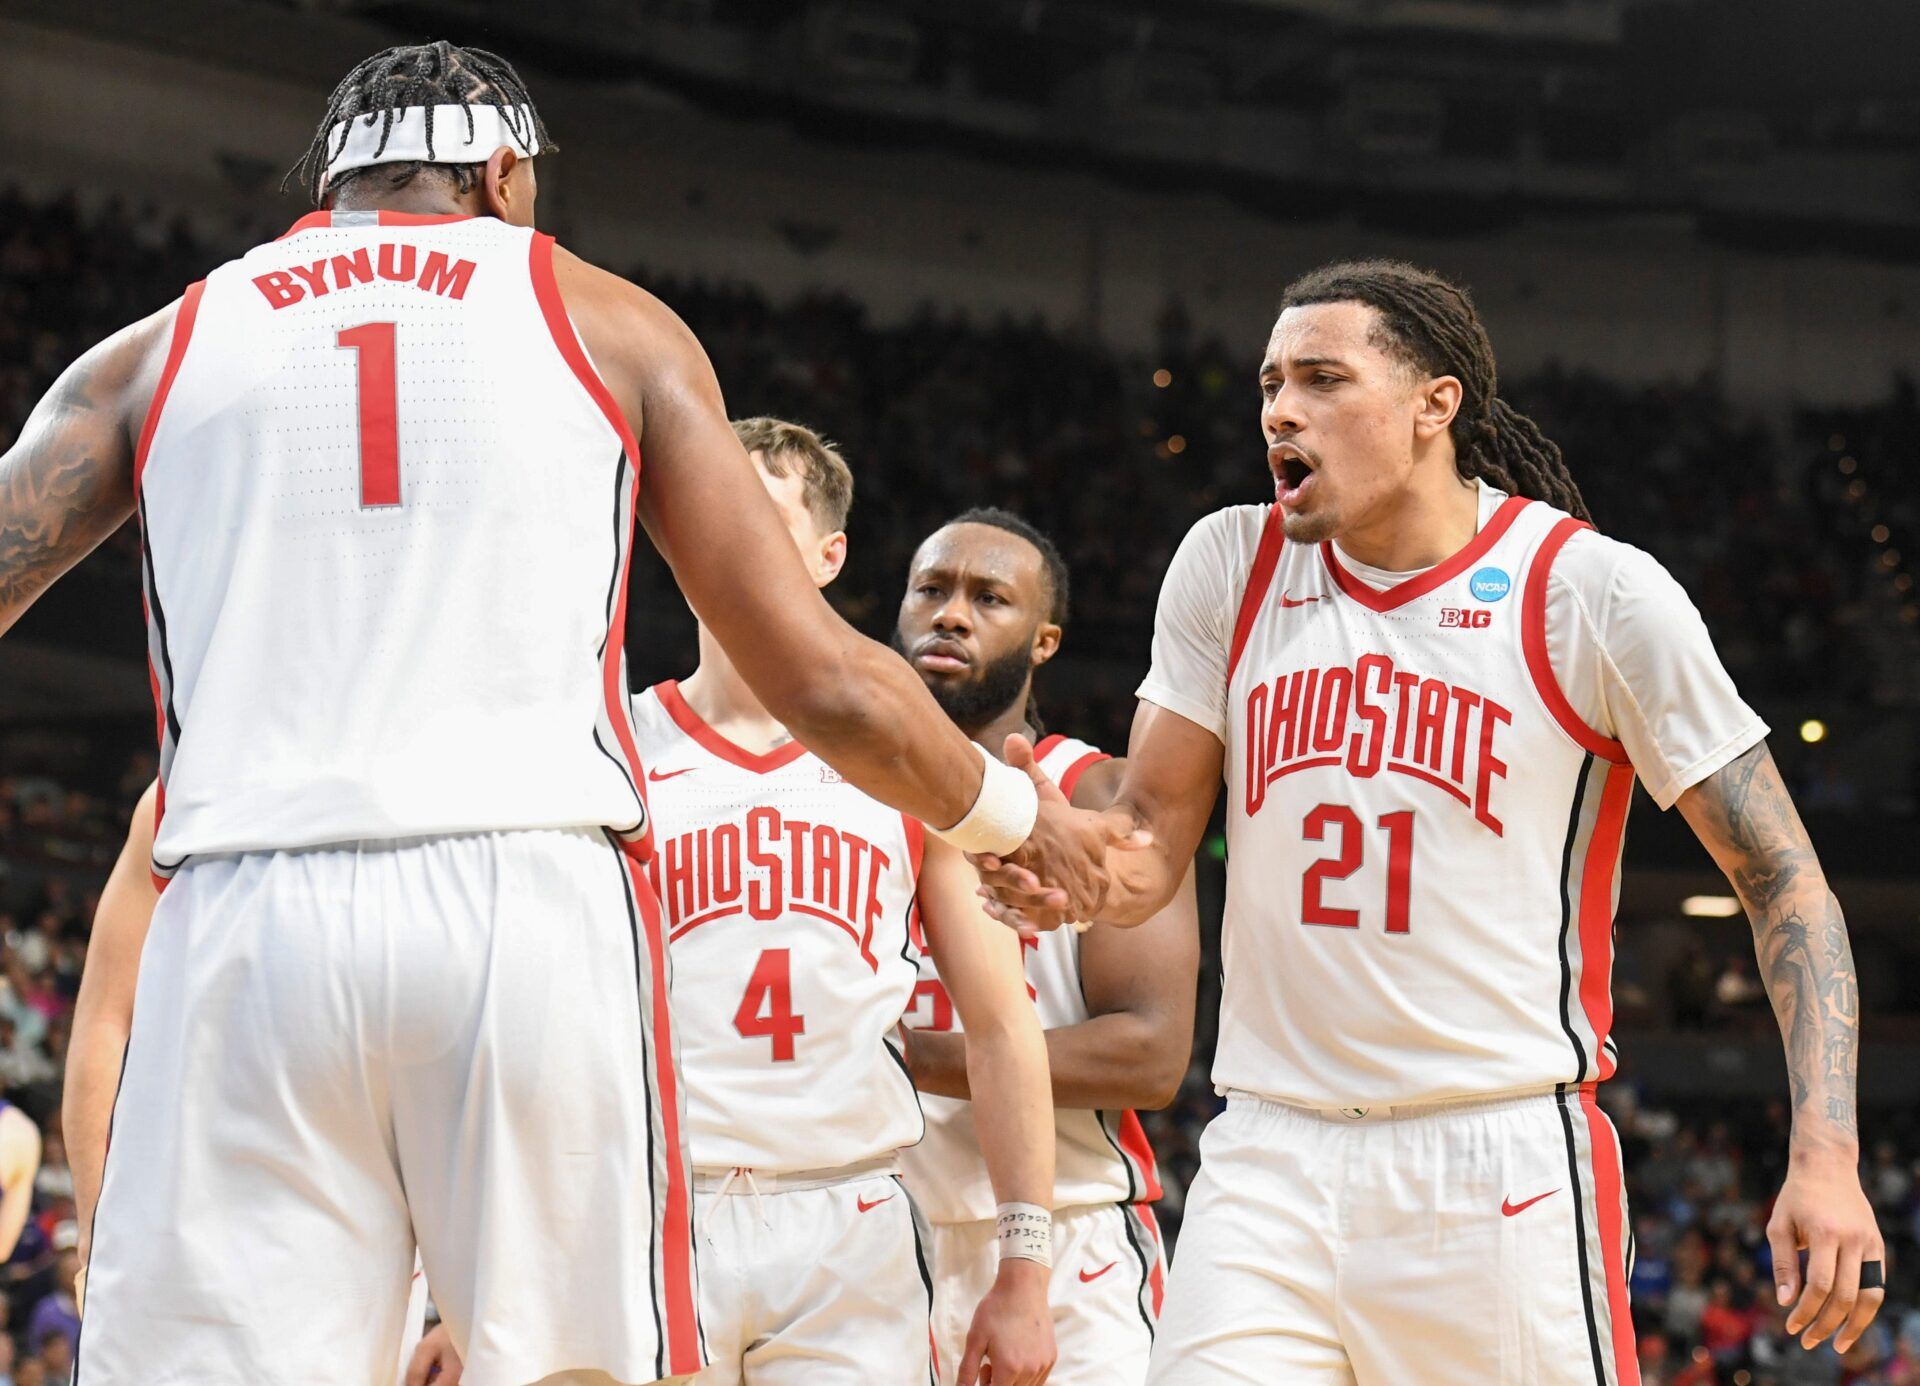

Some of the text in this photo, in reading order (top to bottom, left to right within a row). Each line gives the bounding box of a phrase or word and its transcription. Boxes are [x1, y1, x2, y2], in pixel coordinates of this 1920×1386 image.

[251, 244, 477, 310] BYNUM
[335, 321, 402, 508] 1
[1475, 582, 1507, 592] NCAA
[1301, 803, 1415, 934] 21
[732, 948, 805, 1062] 4
